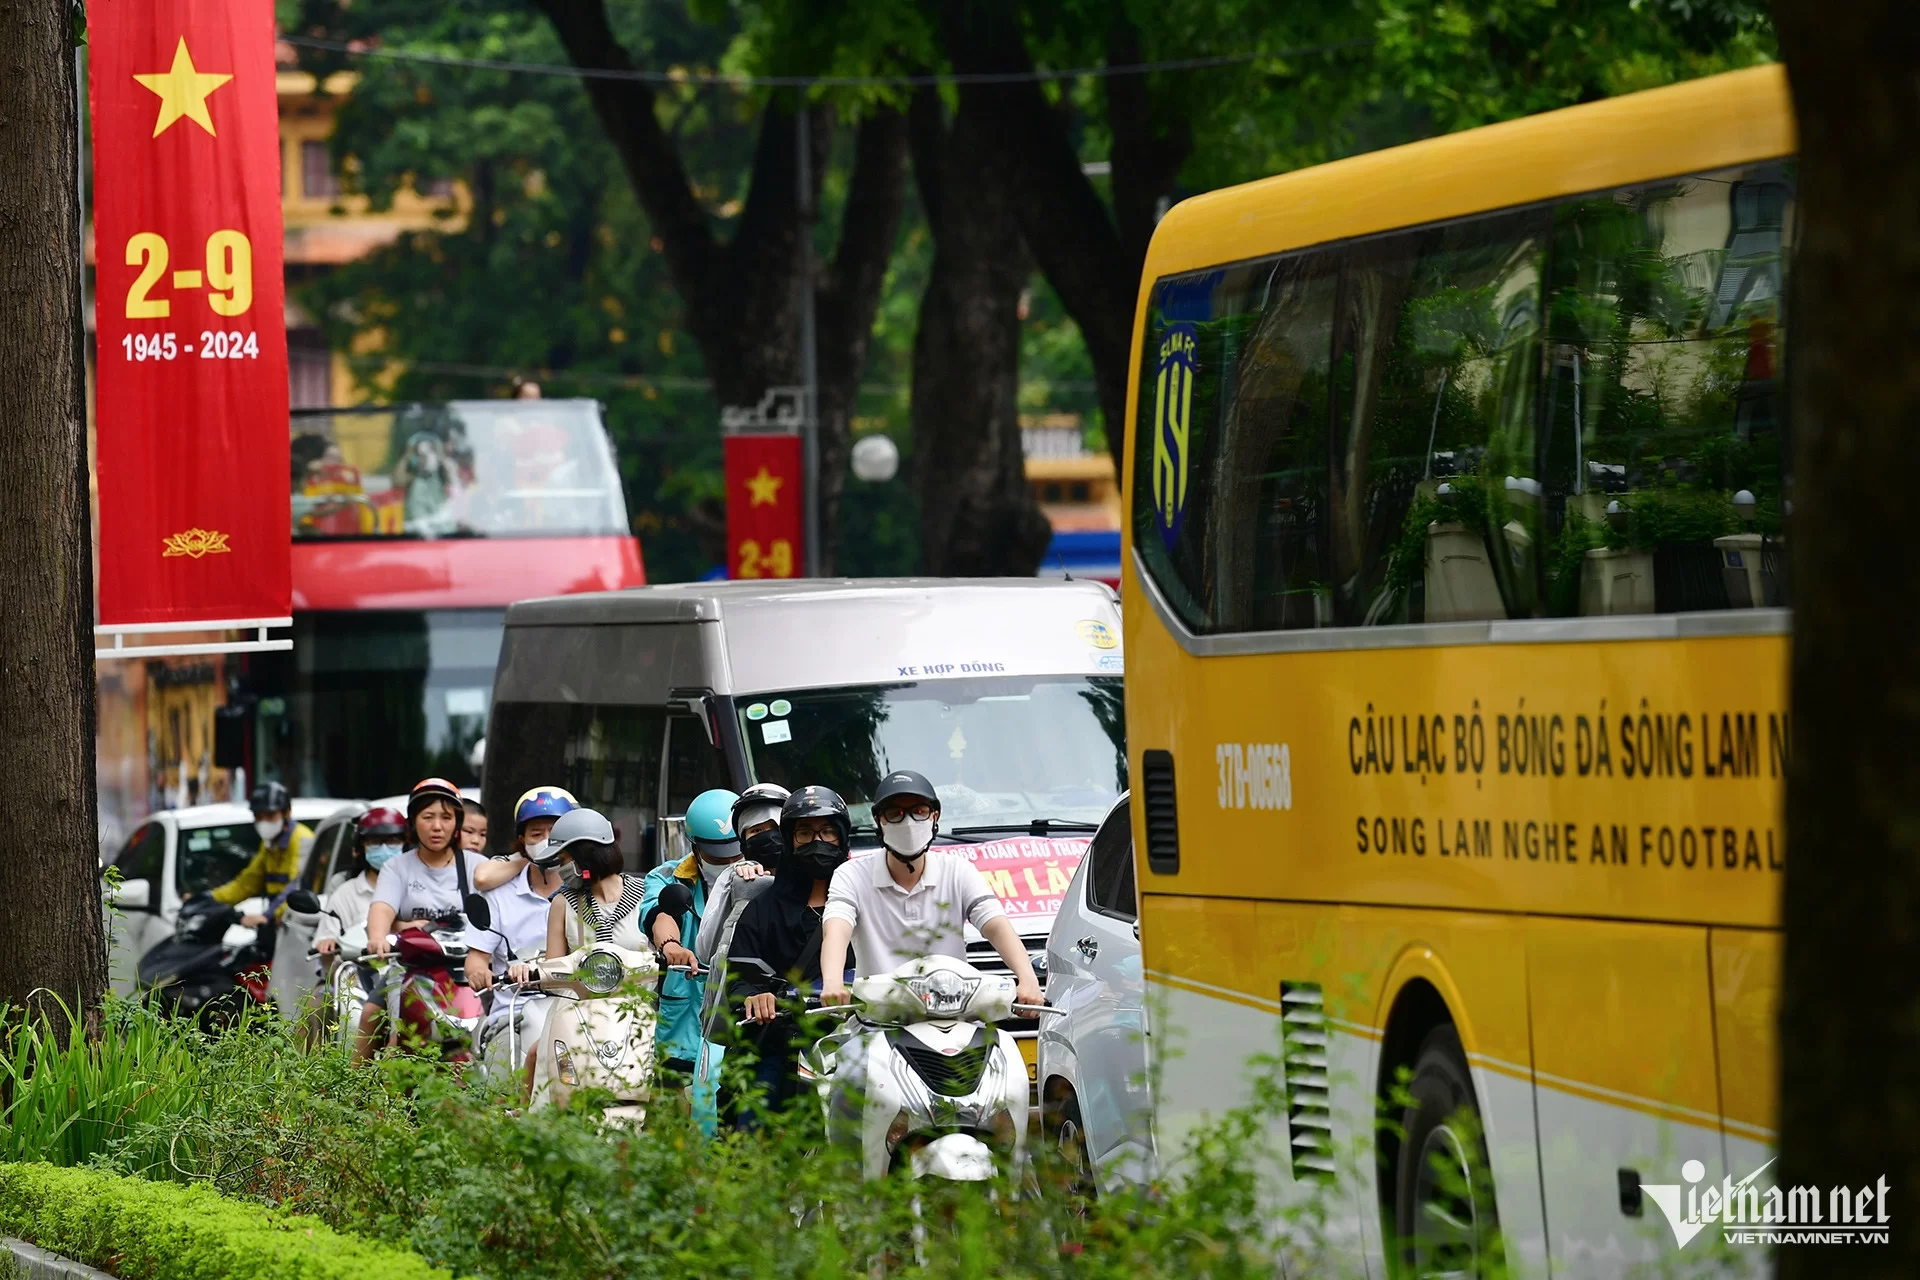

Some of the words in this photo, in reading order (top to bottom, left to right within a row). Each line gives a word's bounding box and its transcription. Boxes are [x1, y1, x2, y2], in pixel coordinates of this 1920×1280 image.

[126, 229, 253, 319] 2-9
[122, 333, 178, 362] 1945
[200, 330, 259, 360] 2024
[739, 538, 793, 578] 2-9
[898, 667, 918, 676] XE
[1402, 713, 1446, 786] LẠC
[1454, 698, 1485, 791] BỘ
[1498, 697, 1565, 778] BÓNG
[1576, 698, 1613, 778] ĐÁ
[1620, 698, 1694, 780] SÔNG
[1702, 711, 1760, 779] LAM
[1356, 816, 1427, 857] SONG
[1438, 818, 1492, 858] LAM
[1503, 821, 1578, 864] NGHE
[1590, 824, 1628, 865] AN
[1640, 826, 1786, 872] FOOTBAL
